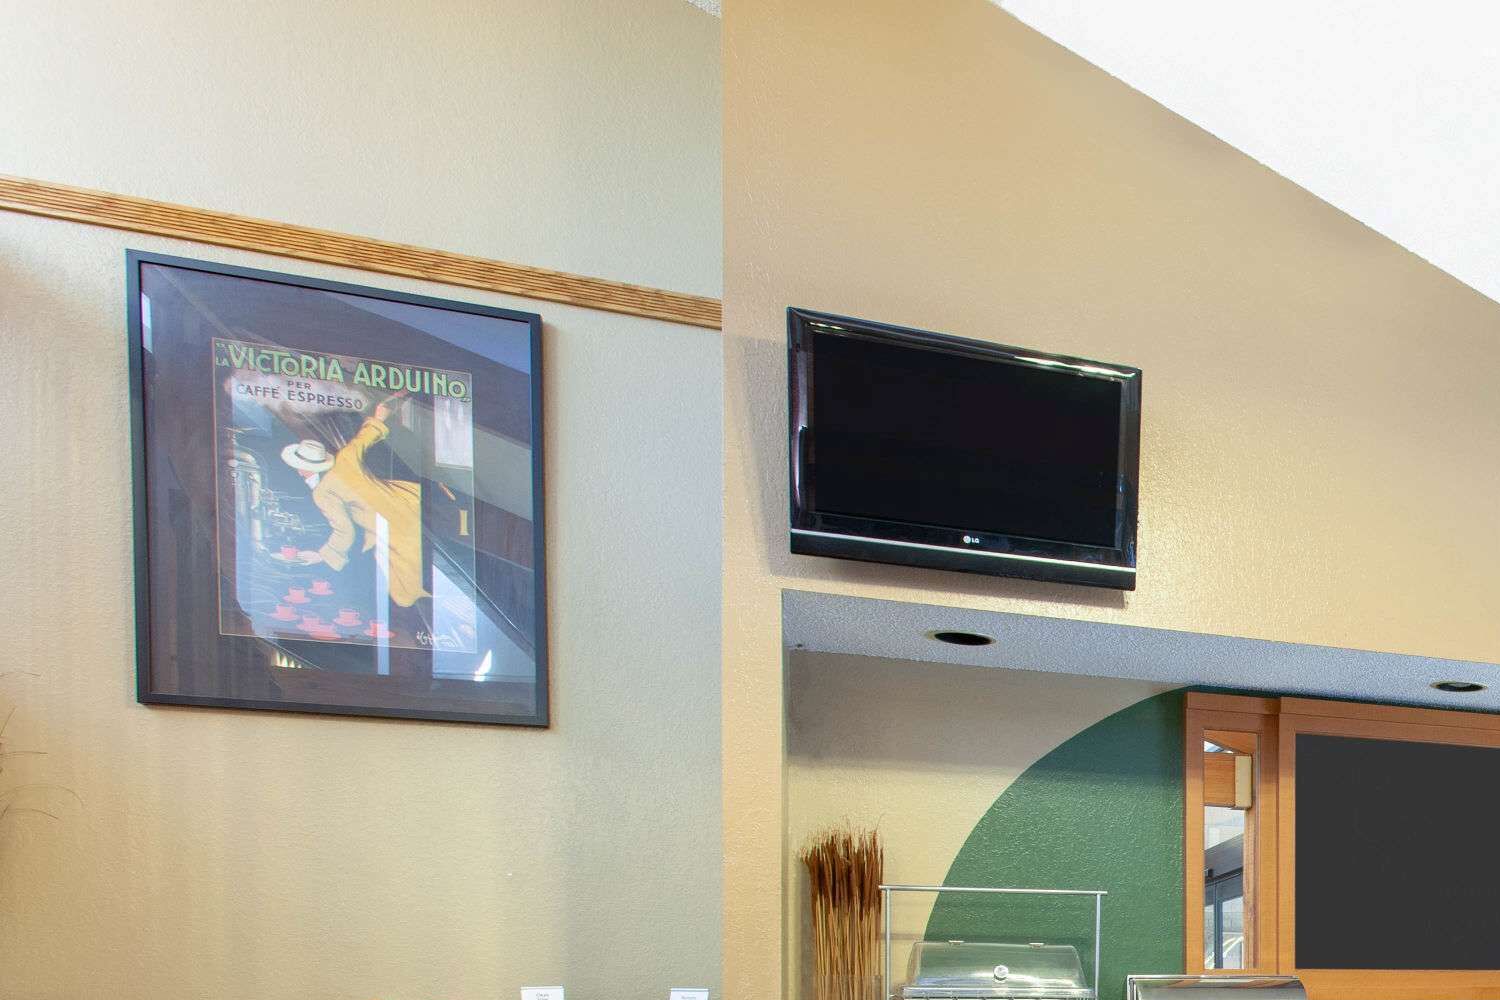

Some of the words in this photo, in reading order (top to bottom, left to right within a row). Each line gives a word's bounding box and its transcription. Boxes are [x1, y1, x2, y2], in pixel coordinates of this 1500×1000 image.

[228, 344, 345, 384] VICTORIA
[287, 380, 312, 391] PER
[287, 390, 364, 411] ESPRESSO
